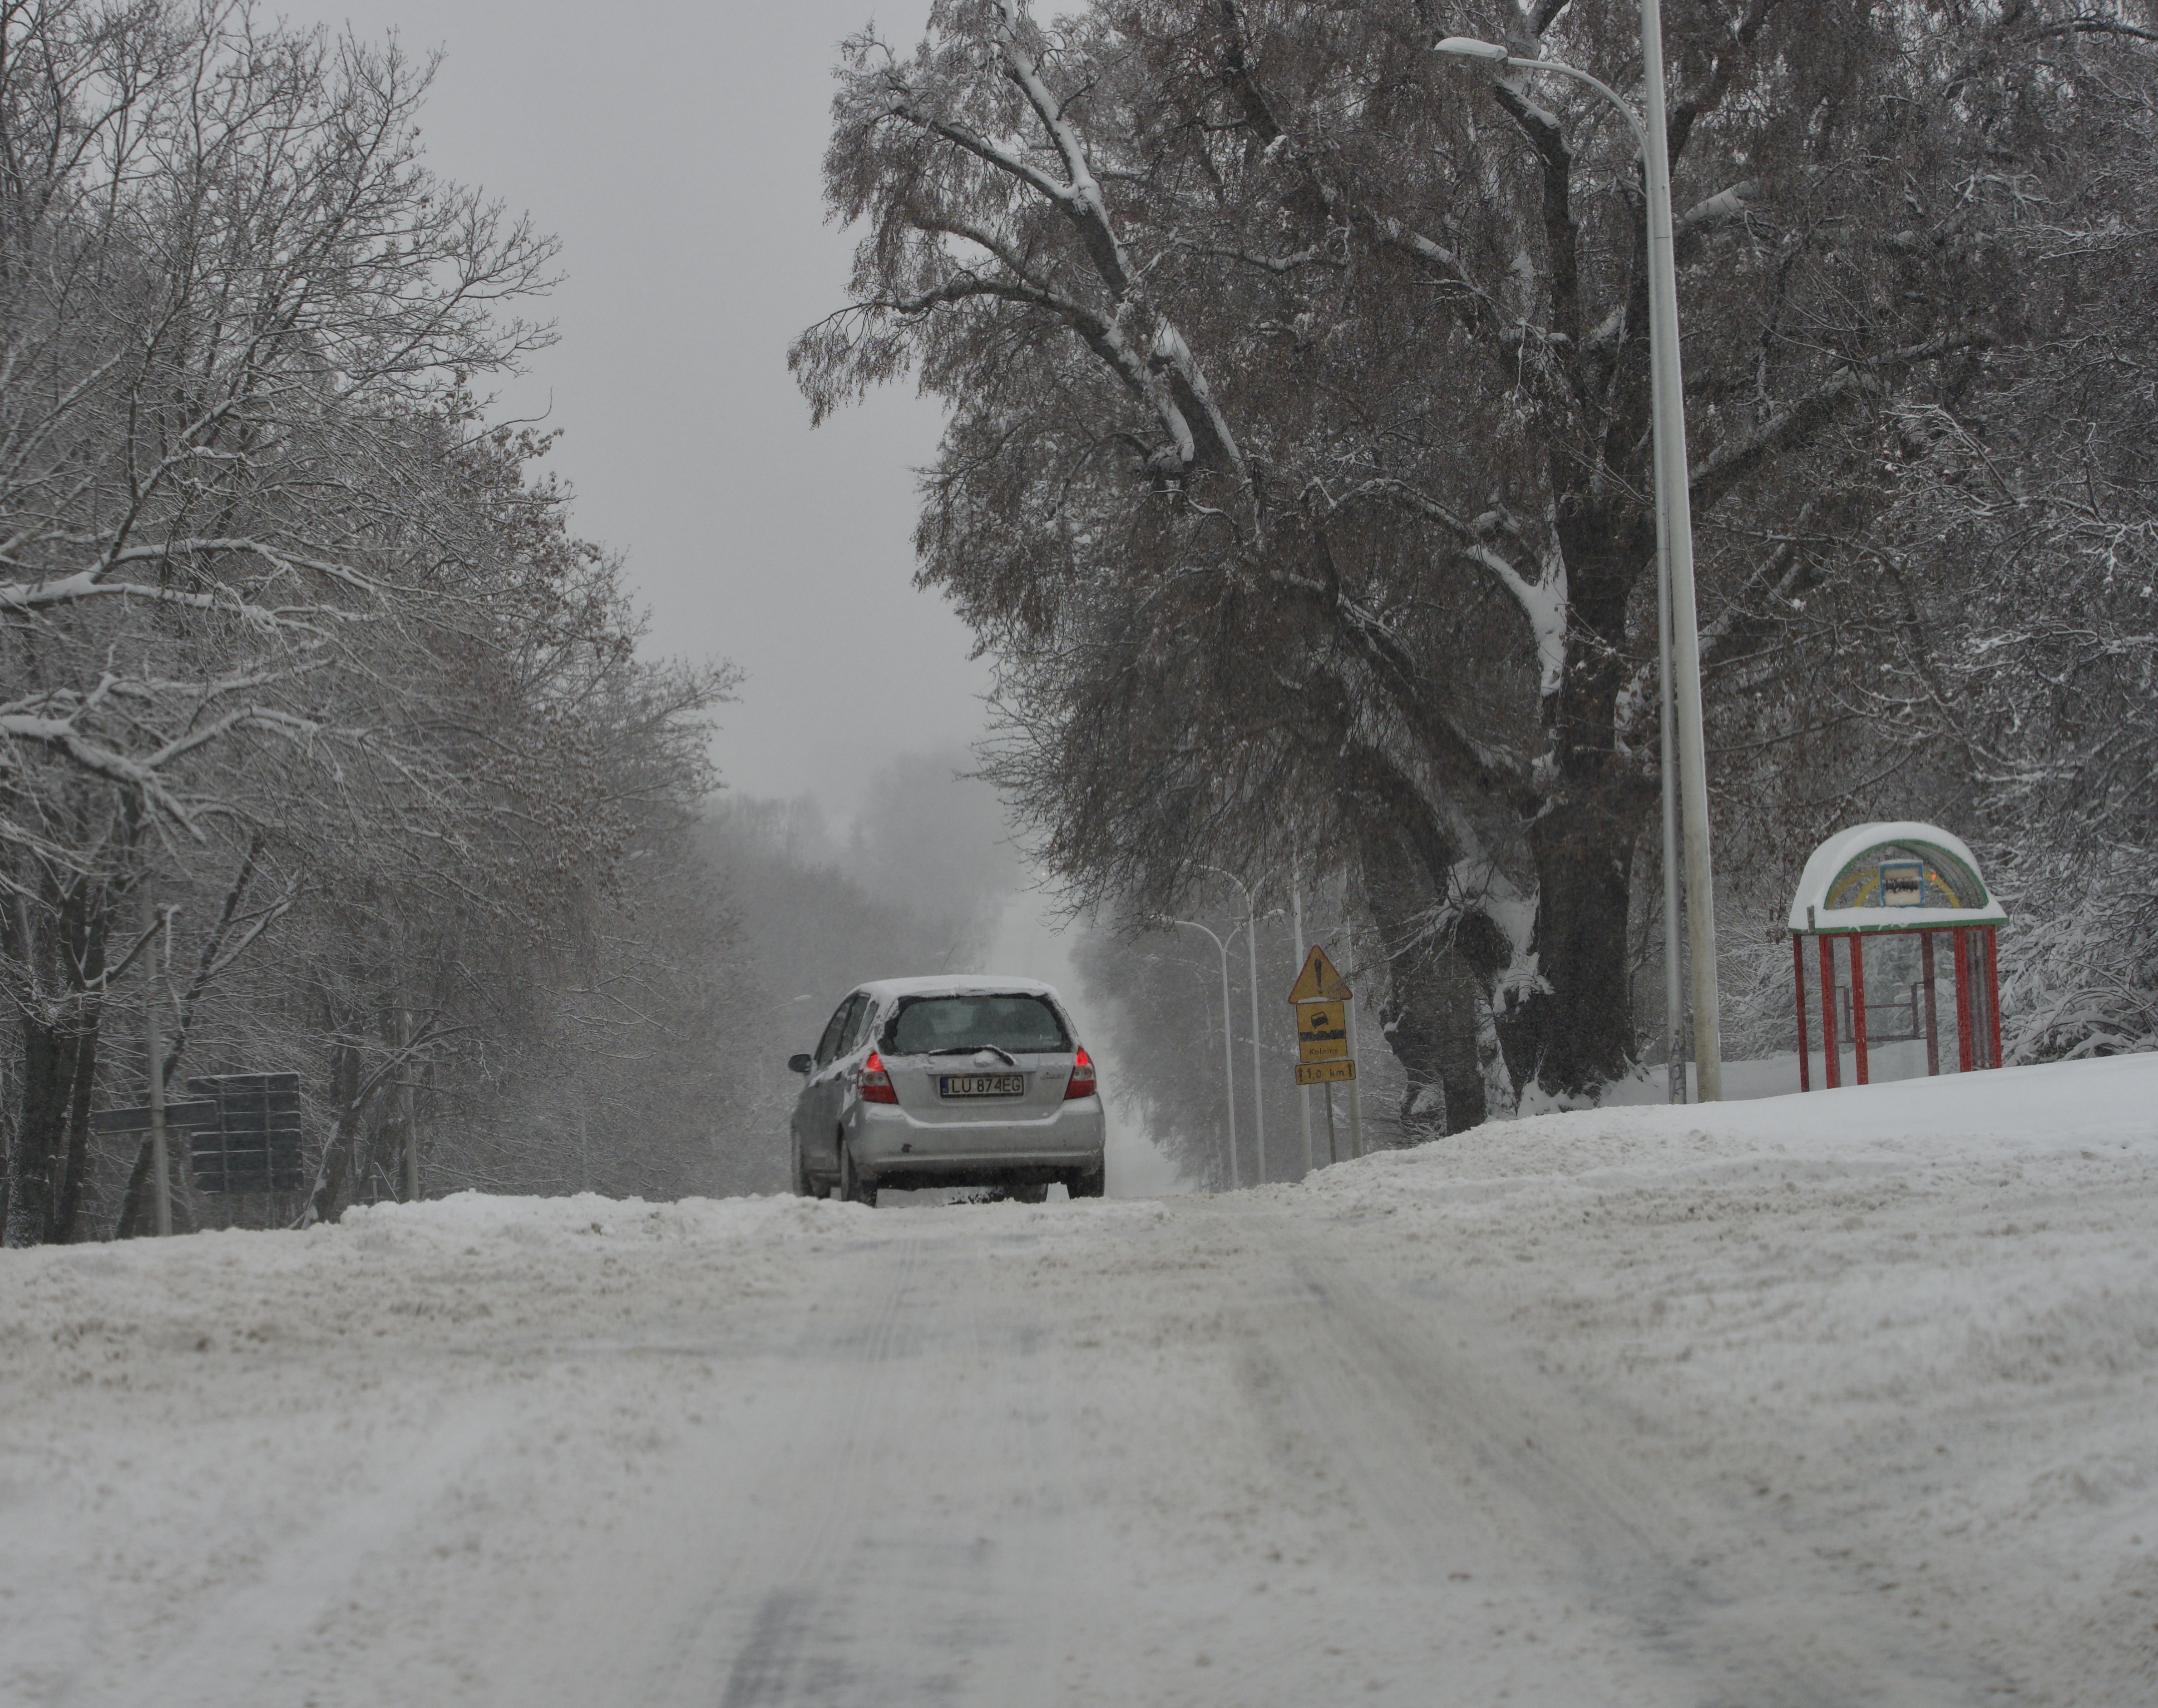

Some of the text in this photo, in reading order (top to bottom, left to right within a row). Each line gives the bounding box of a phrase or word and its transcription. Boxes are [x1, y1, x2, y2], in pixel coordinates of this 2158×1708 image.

[1307, 1068, 1344, 1081] 1,0 km
[952, 1078, 1021, 1093] LU 874EG
